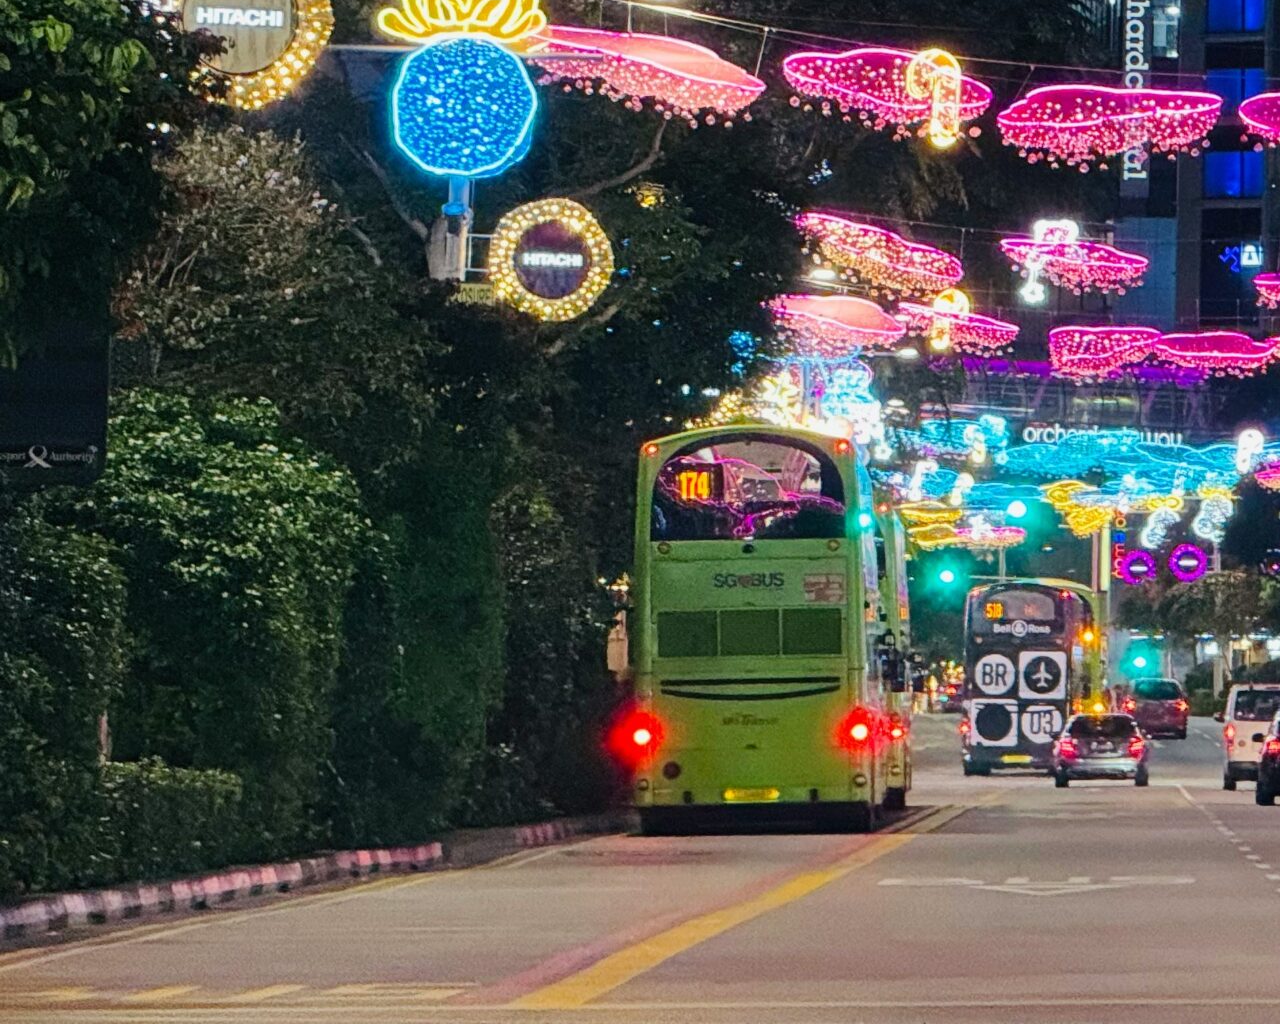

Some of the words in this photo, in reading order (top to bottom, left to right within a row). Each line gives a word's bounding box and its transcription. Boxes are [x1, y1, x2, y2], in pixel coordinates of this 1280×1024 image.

[196, 6, 284, 27] HITACHI
[523, 252, 583, 267] HITACHI
[680, 471, 709, 499] 174
[713, 573, 738, 589] SG
[751, 572, 785, 588] BUS
[981, 663, 1007, 687] BR
